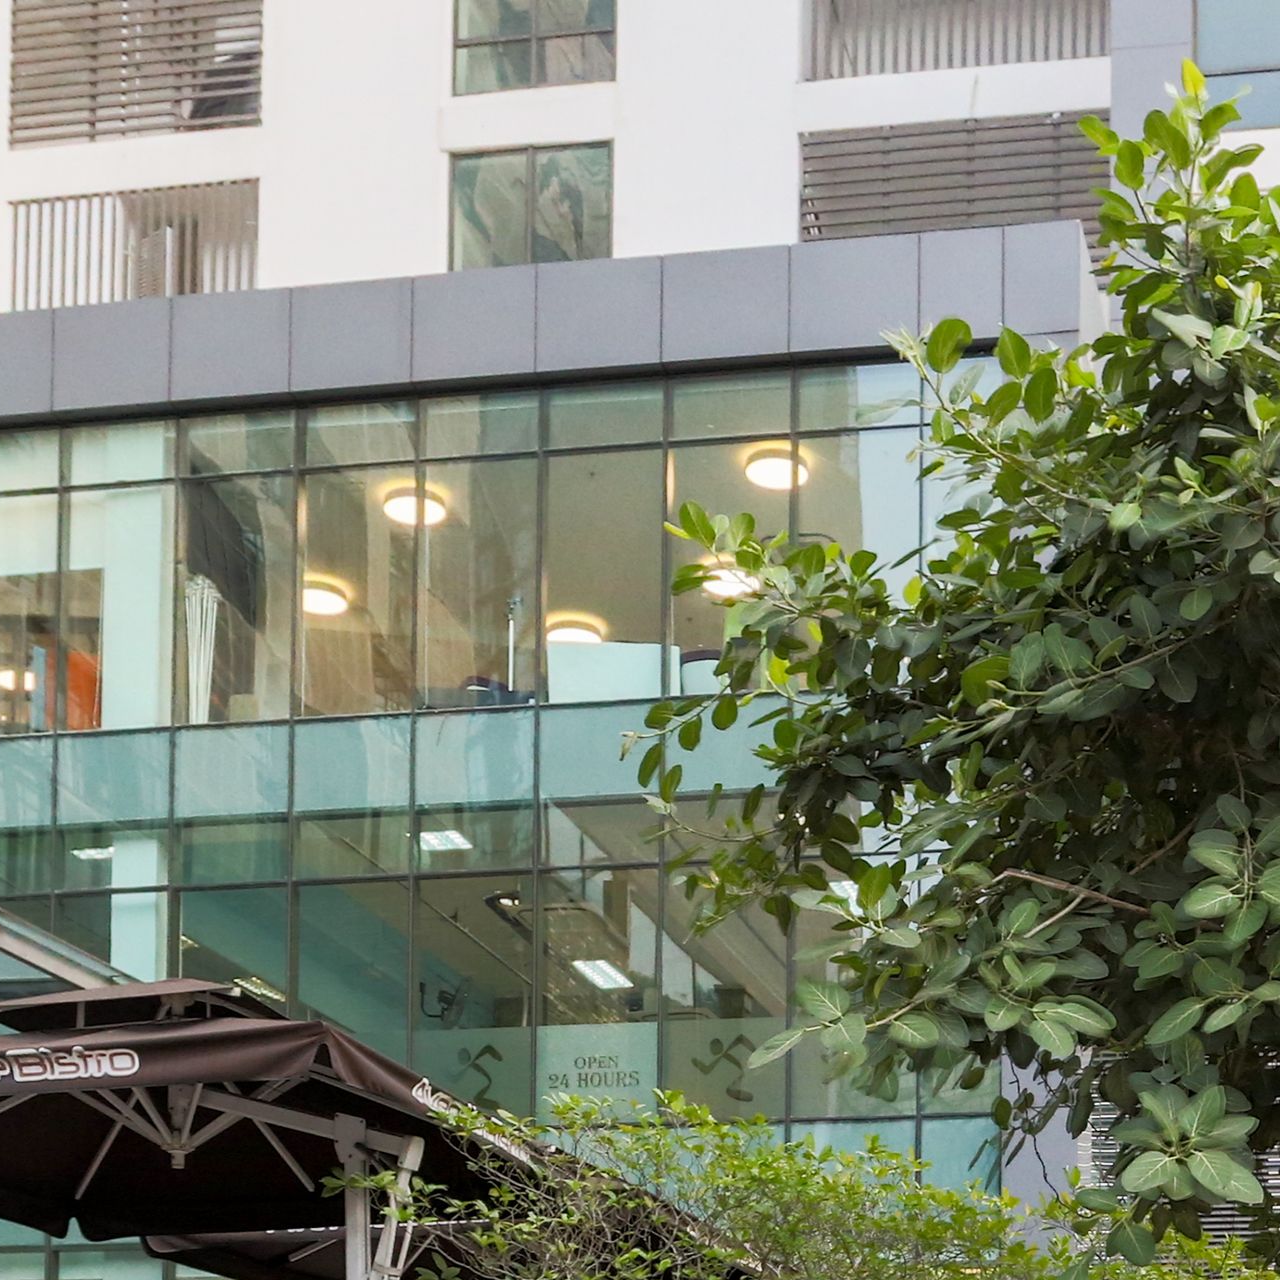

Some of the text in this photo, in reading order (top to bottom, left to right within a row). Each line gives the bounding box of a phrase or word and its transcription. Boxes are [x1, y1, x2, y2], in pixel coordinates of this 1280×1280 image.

[7, 1048, 140, 1082] Bistro
[574, 1056, 619, 1070] OPEN
[548, 1070, 640, 1089] 24 HOURS
